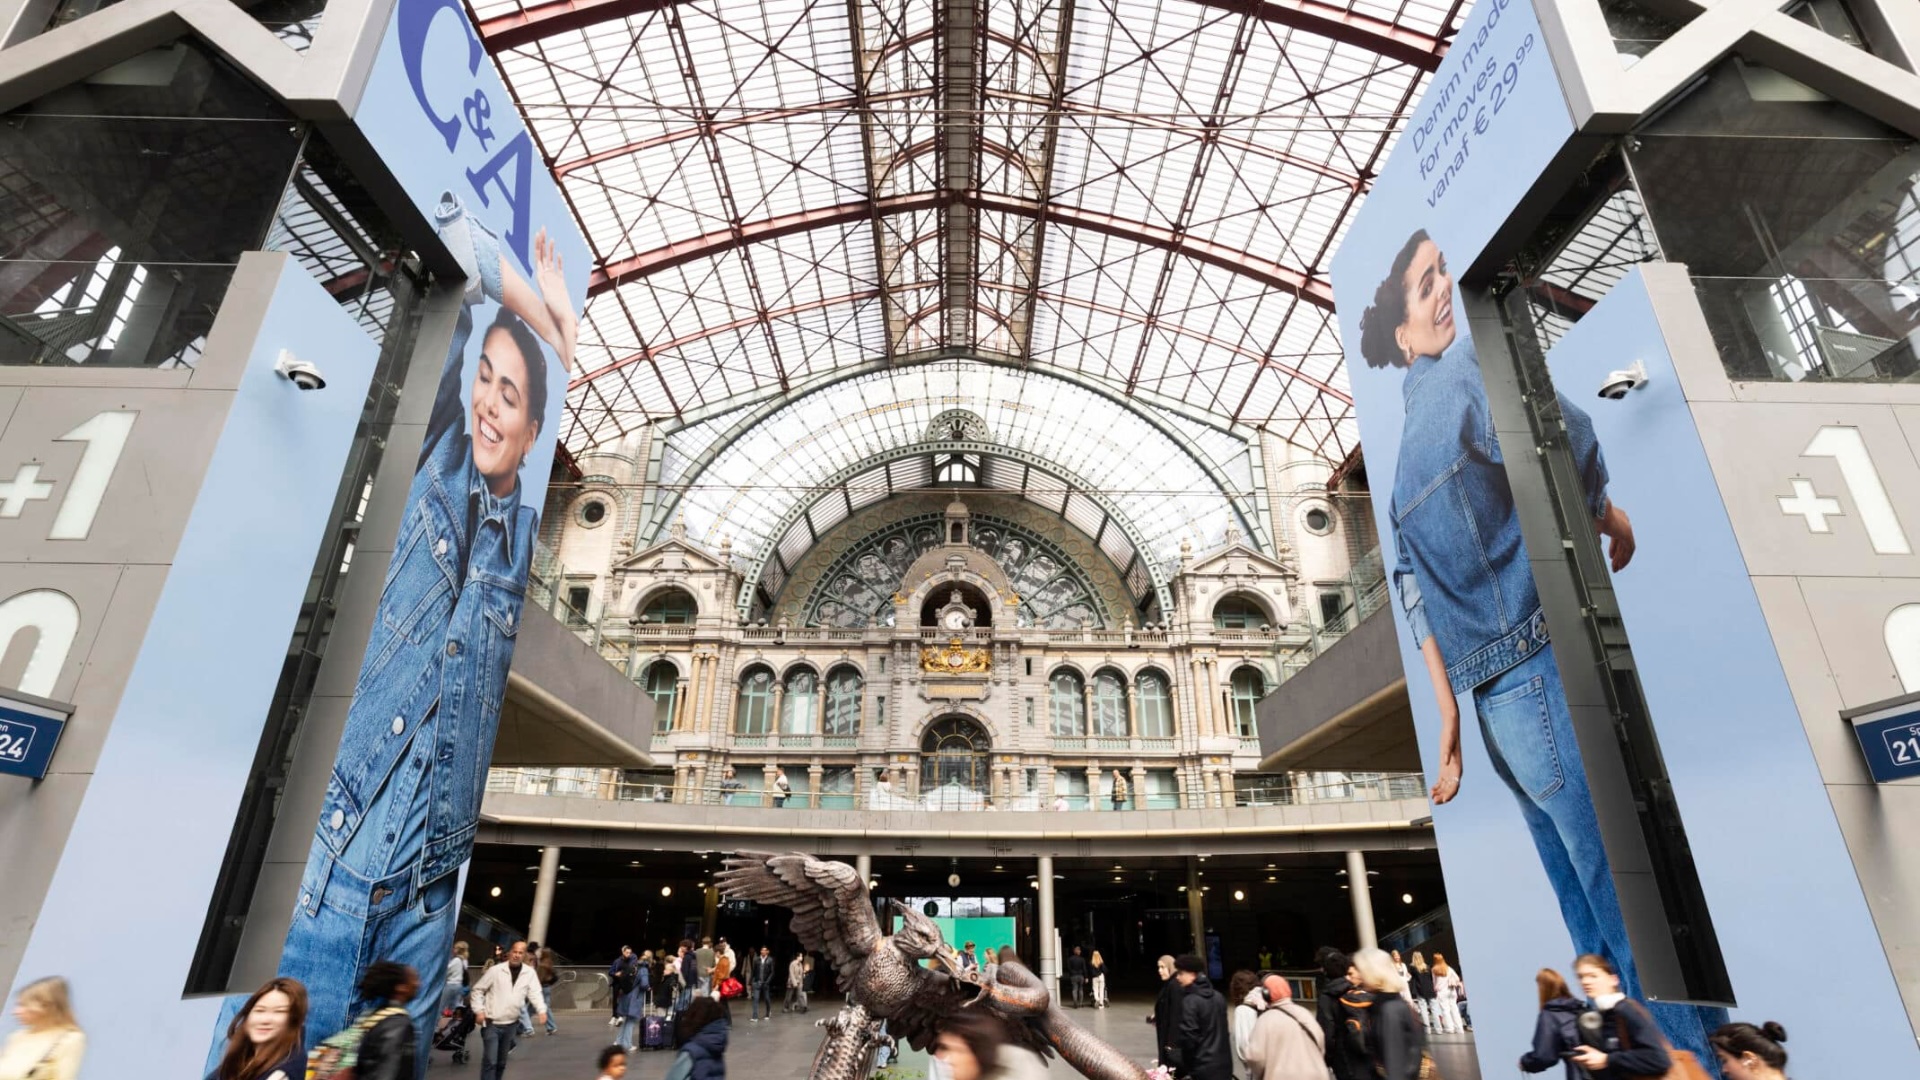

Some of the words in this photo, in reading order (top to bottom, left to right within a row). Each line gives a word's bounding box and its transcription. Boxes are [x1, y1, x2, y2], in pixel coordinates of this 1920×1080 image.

[398, 0, 533, 279] C&A
[1412, 72, 1460, 154] Denim
[1419, 142, 1440, 181] for
[1443, 56, 1497, 146] moves
[1426, 132, 1469, 209] vanaf
[1776, 425, 1914, 554] +1
[0, 734, 25, 758] 24
